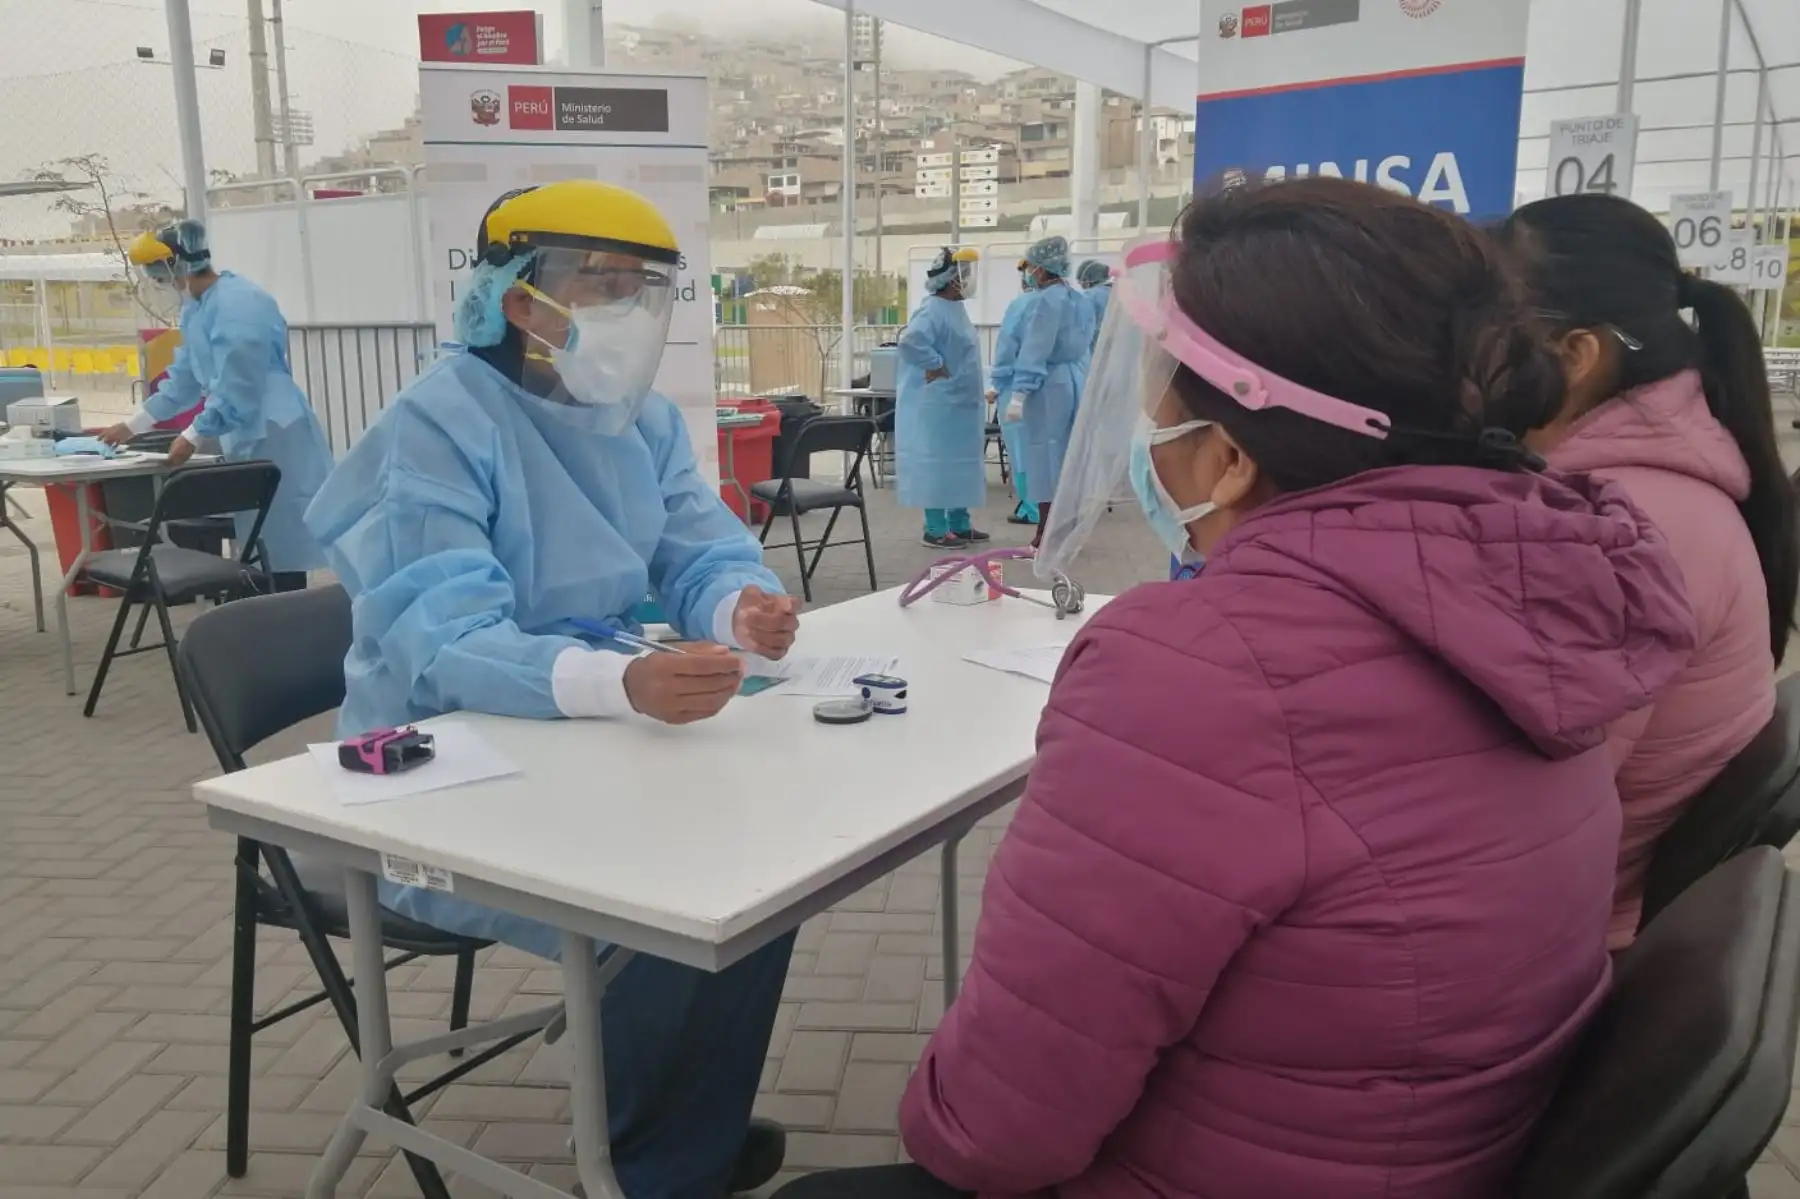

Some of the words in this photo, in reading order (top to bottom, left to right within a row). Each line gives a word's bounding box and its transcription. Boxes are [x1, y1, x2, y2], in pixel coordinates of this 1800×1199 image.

[514, 99, 548, 114] PERÚ
[561, 103, 612, 113] Ministerio
[562, 114, 575, 124] de
[577, 115, 604, 124] Salud
[1606, 118, 1625, 130] DE
[1572, 132, 1613, 147] TRIAJE
[1555, 153, 1618, 196] 04
[1674, 216, 1721, 249] 06
[1754, 259, 1782, 279] 10
